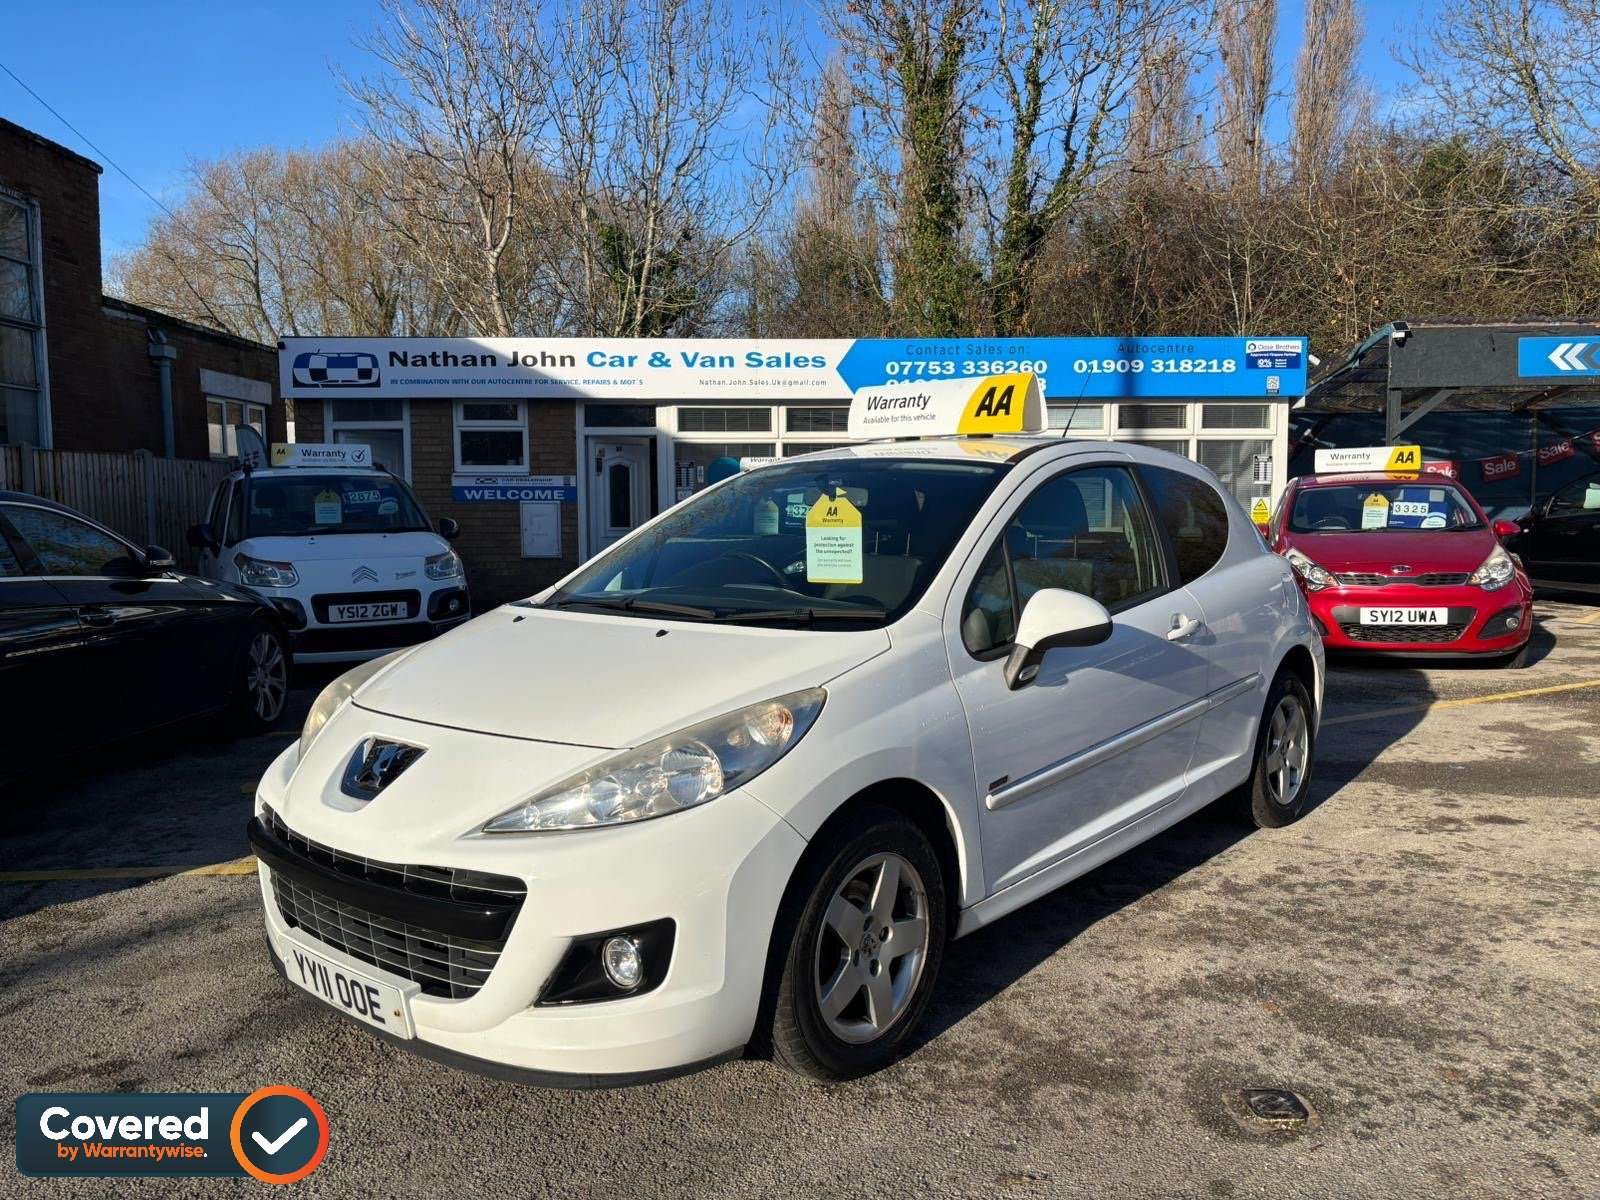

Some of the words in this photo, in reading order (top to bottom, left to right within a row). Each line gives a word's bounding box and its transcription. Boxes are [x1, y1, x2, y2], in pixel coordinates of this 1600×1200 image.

[905, 344, 960, 356] Contact
[967, 344, 1003, 356] Sales
[1009, 345, 1031, 355] on:
[1117, 343, 1195, 353] Autocentre
[388, 351, 497, 368] Nathan
[506, 351, 576, 368] John
[586, 351, 638, 368] Car
[647, 351, 672, 368] &
[680, 351, 735, 368] Van
[744, 351, 827, 368] Sales
[885, 360, 956, 375] 07753
[962, 360, 1048, 374] 336260
[1073, 359, 1144, 374] 01909
[1151, 359, 1236, 374] 318218
[867, 393, 931, 411] Warranty
[974, 386, 1015, 417] AA
[863, 415, 890, 424] Available
[890, 415, 900, 423] for
[901, 414, 912, 422] this
[913, 413, 936, 422] vehicle
[301, 448, 346, 459] Warranty
[1540, 441, 1569, 459] Sale
[1330, 452, 1371, 461] Warranty
[1394, 451, 1414, 464] AA
[1484, 459, 1516, 475] Sale
[464, 489, 566, 500] WELCOME
[826, 506, 838, 517] AA
[1395, 504, 1427, 513] 3325
[337, 606, 368, 619] YS12
[371, 604, 398, 617] ZGW
[1370, 610, 1403, 623] SY12
[1408, 610, 1437, 623] UWA
[293, 949, 334, 1000] YY11
